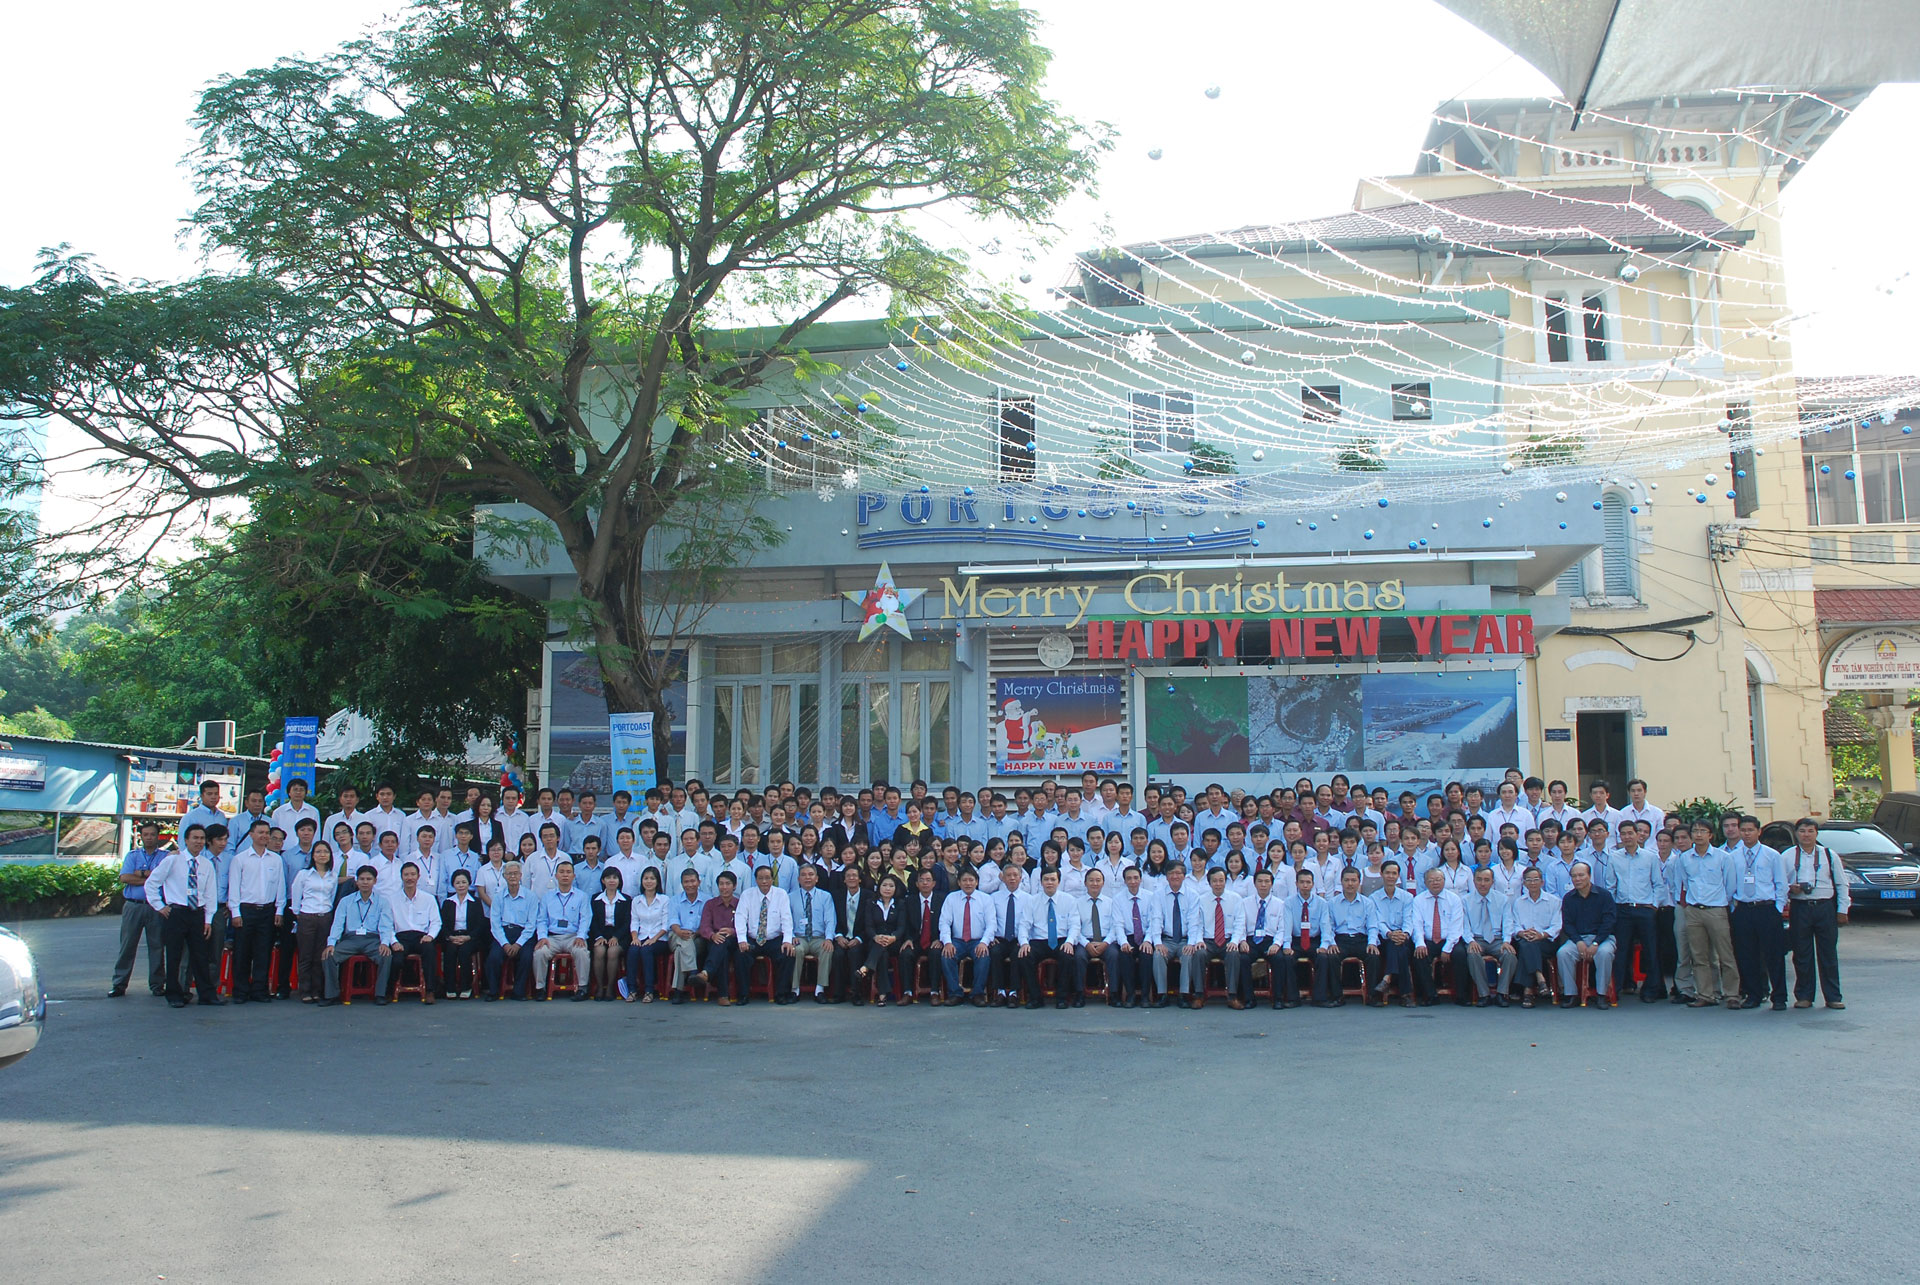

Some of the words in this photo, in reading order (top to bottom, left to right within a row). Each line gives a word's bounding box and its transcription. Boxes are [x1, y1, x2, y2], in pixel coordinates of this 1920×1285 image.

[857, 480, 1250, 526] PORTCOAST
[939, 576, 1099, 630] Merry
[1124, 571, 1406, 615] Christmas
[1088, 619, 1243, 659] HAPPY
[1270, 617, 1380, 657] NEW
[1407, 615, 1534, 655] YEAR
[1832, 664, 1849, 672] TRUNG
[1851, 662, 1862, 672] TÂM
[1004, 682, 1043, 699] Merry
[1047, 682, 1115, 695] Christmas
[613, 722, 651, 732] PORTCOAST
[1004, 762, 1045, 770] HAPPY
[1049, 762, 1077, 770] NEW
[1080, 761, 1114, 769] YEAR
